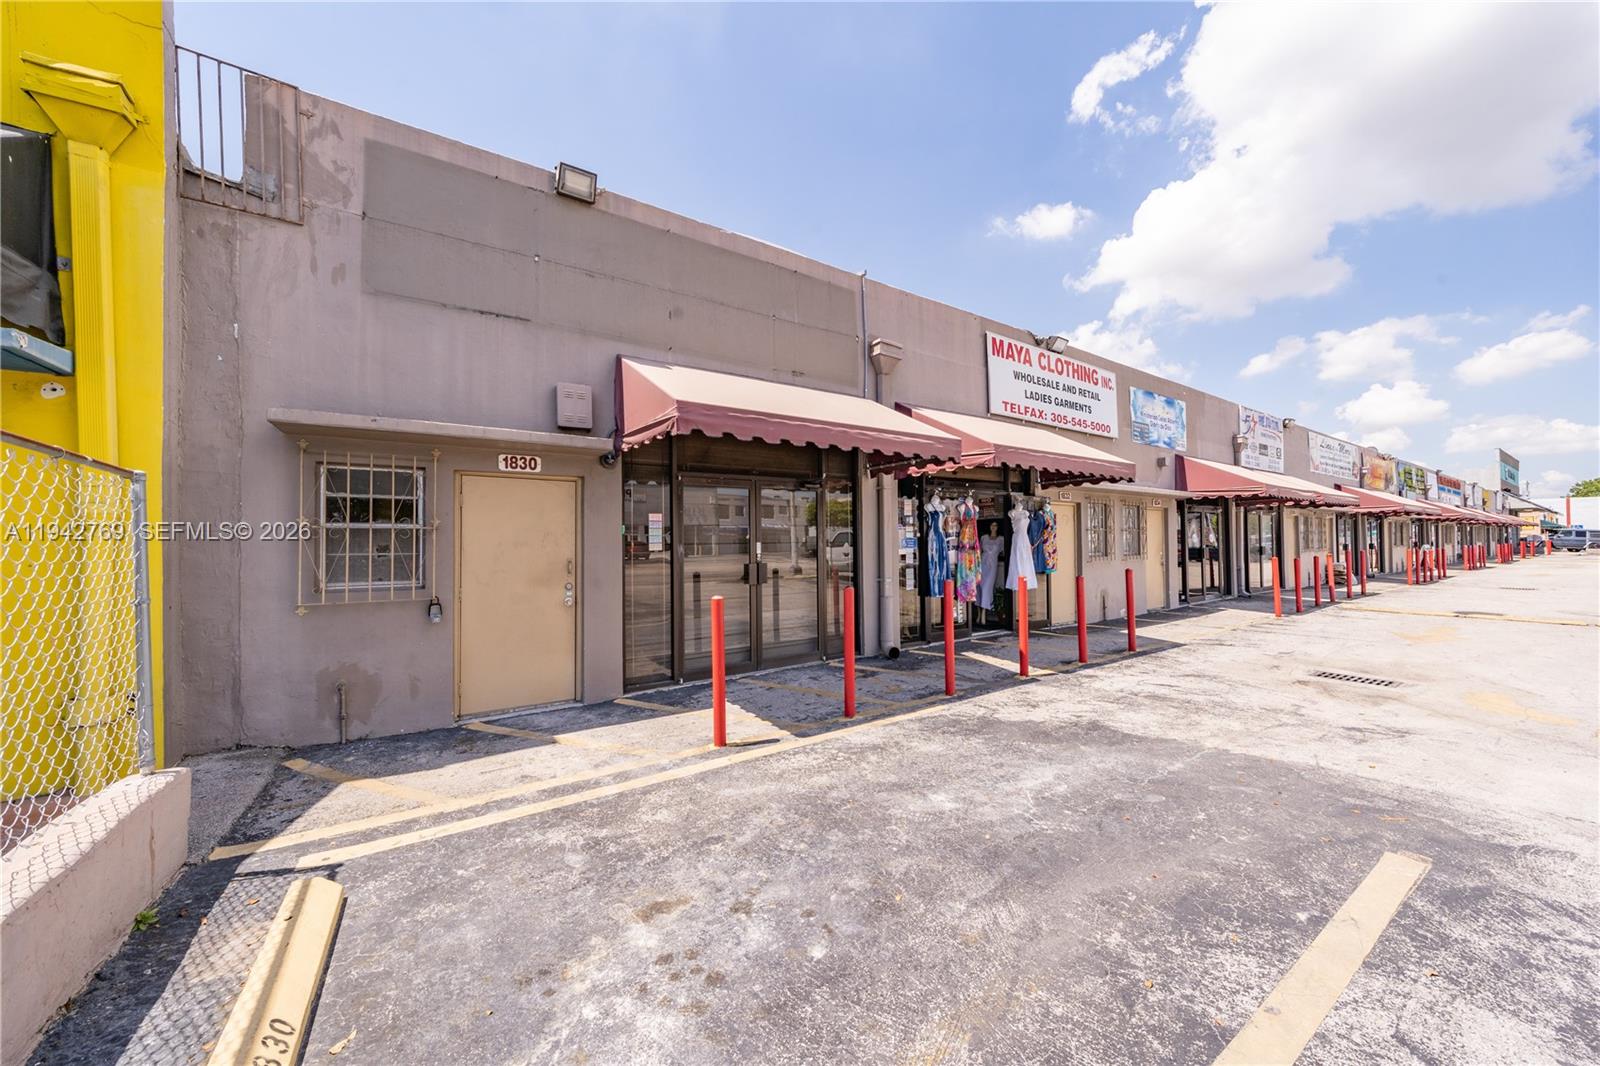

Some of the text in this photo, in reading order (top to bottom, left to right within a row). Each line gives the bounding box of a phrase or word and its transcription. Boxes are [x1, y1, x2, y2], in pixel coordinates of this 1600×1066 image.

[991, 336, 1115, 391] MAYA CLOTHING INC.
[1013, 370, 1102, 402] WHOLESALE AND RETAIL
[1024, 389, 1093, 415] LADIES GARMENTS
[1002, 400, 1048, 420] TELFAX:
[1050, 412, 1112, 434] 305-545-5000
[502, 455, 538, 471] 1830
